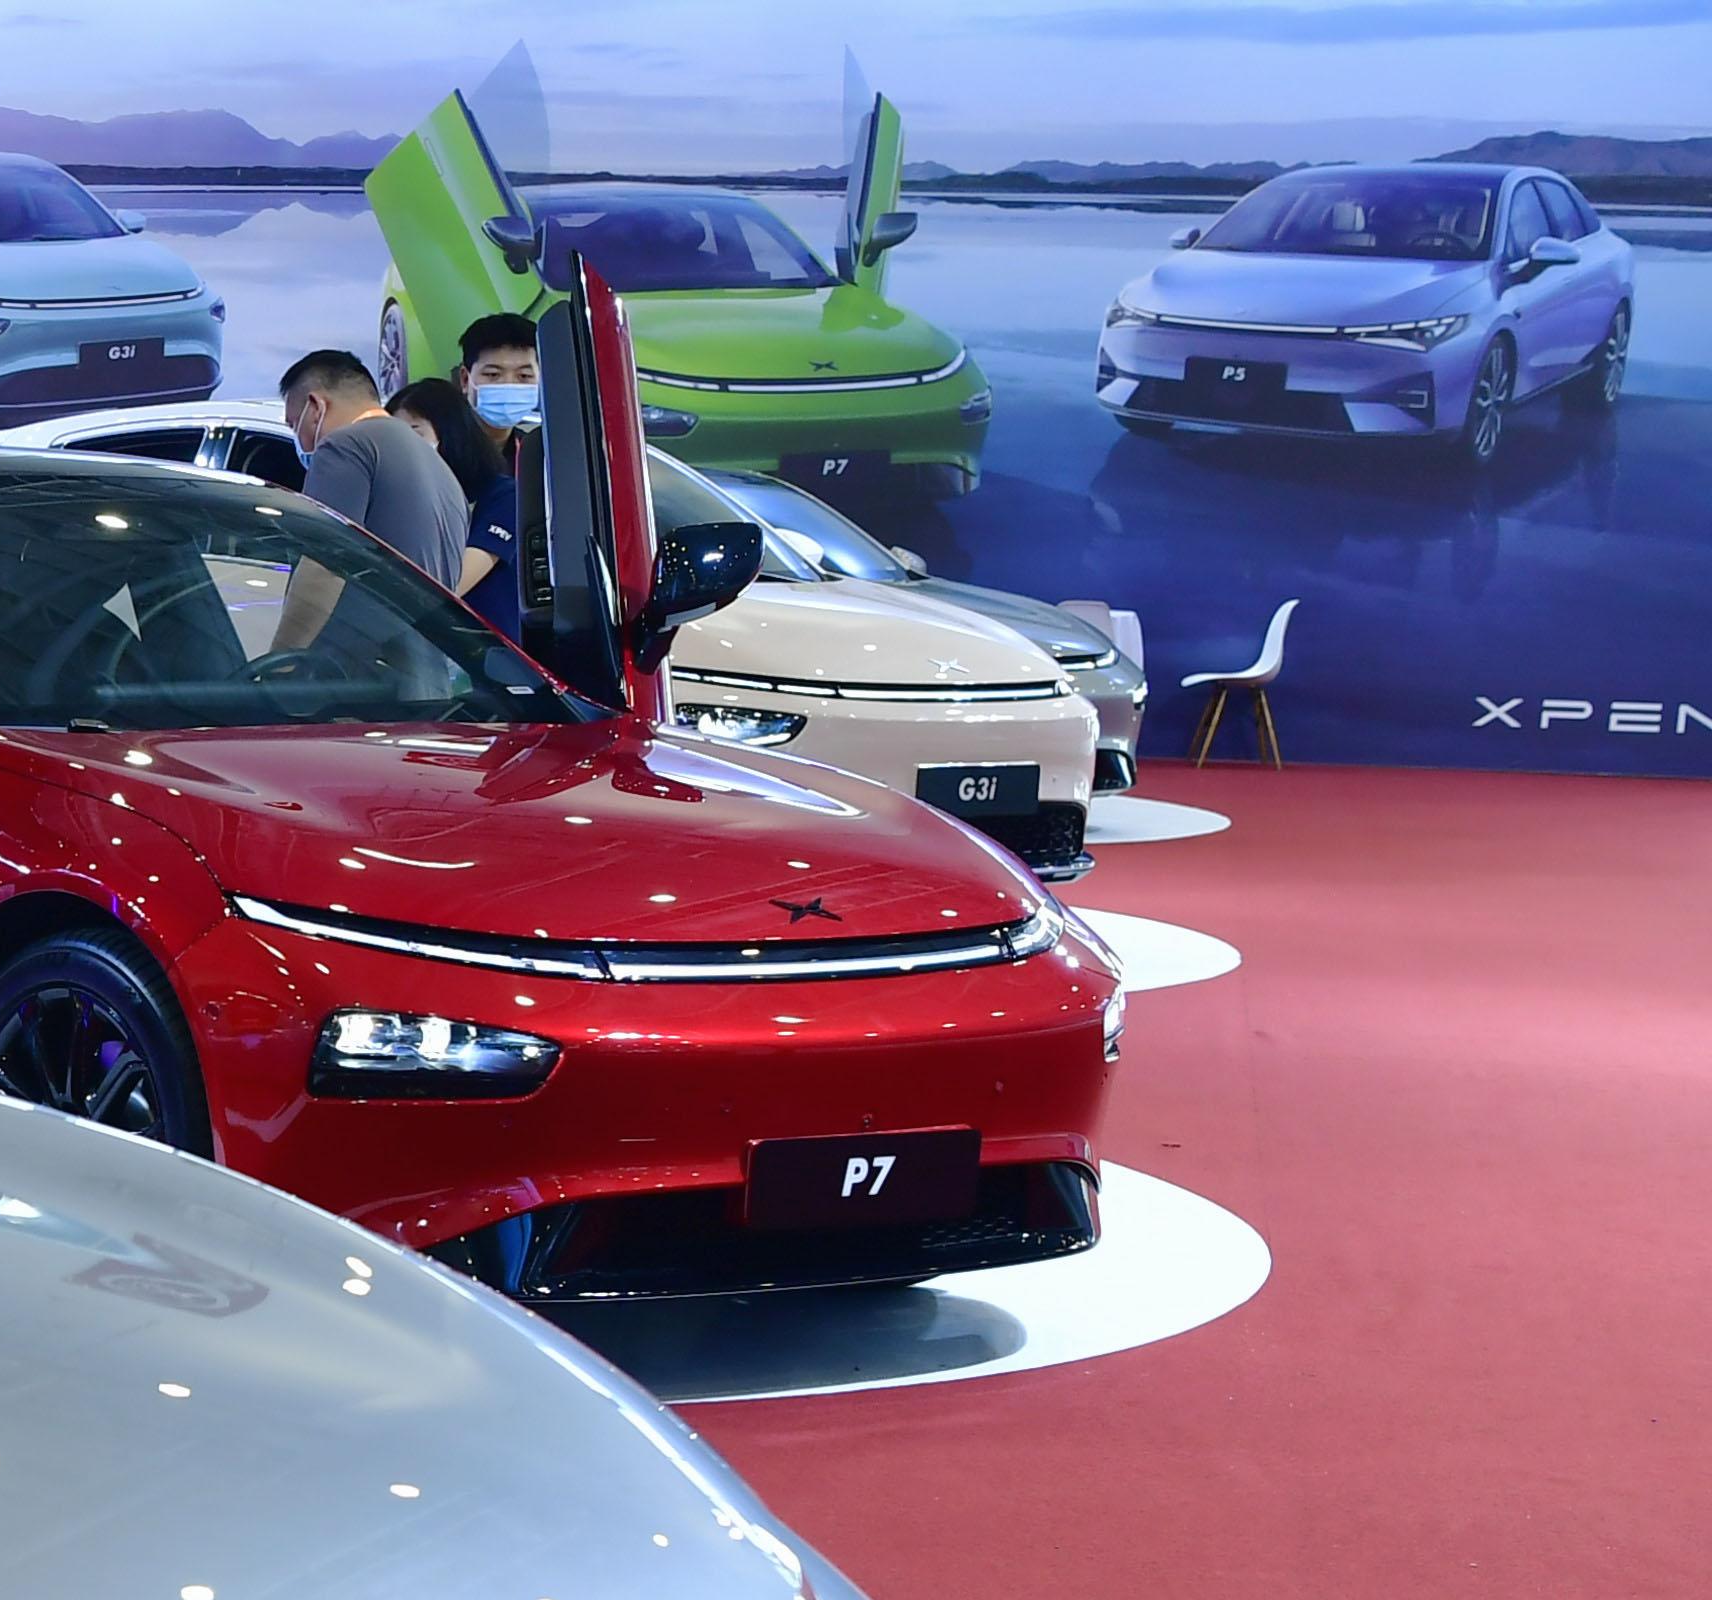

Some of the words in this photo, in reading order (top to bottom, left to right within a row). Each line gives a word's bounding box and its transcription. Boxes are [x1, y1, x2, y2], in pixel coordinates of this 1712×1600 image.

[108, 345, 136, 360] G3i
[1222, 366, 1246, 381] P5
[822, 459, 849, 476] P7
[958, 776, 998, 801] G3i
[841, 1156, 896, 1197] P7
